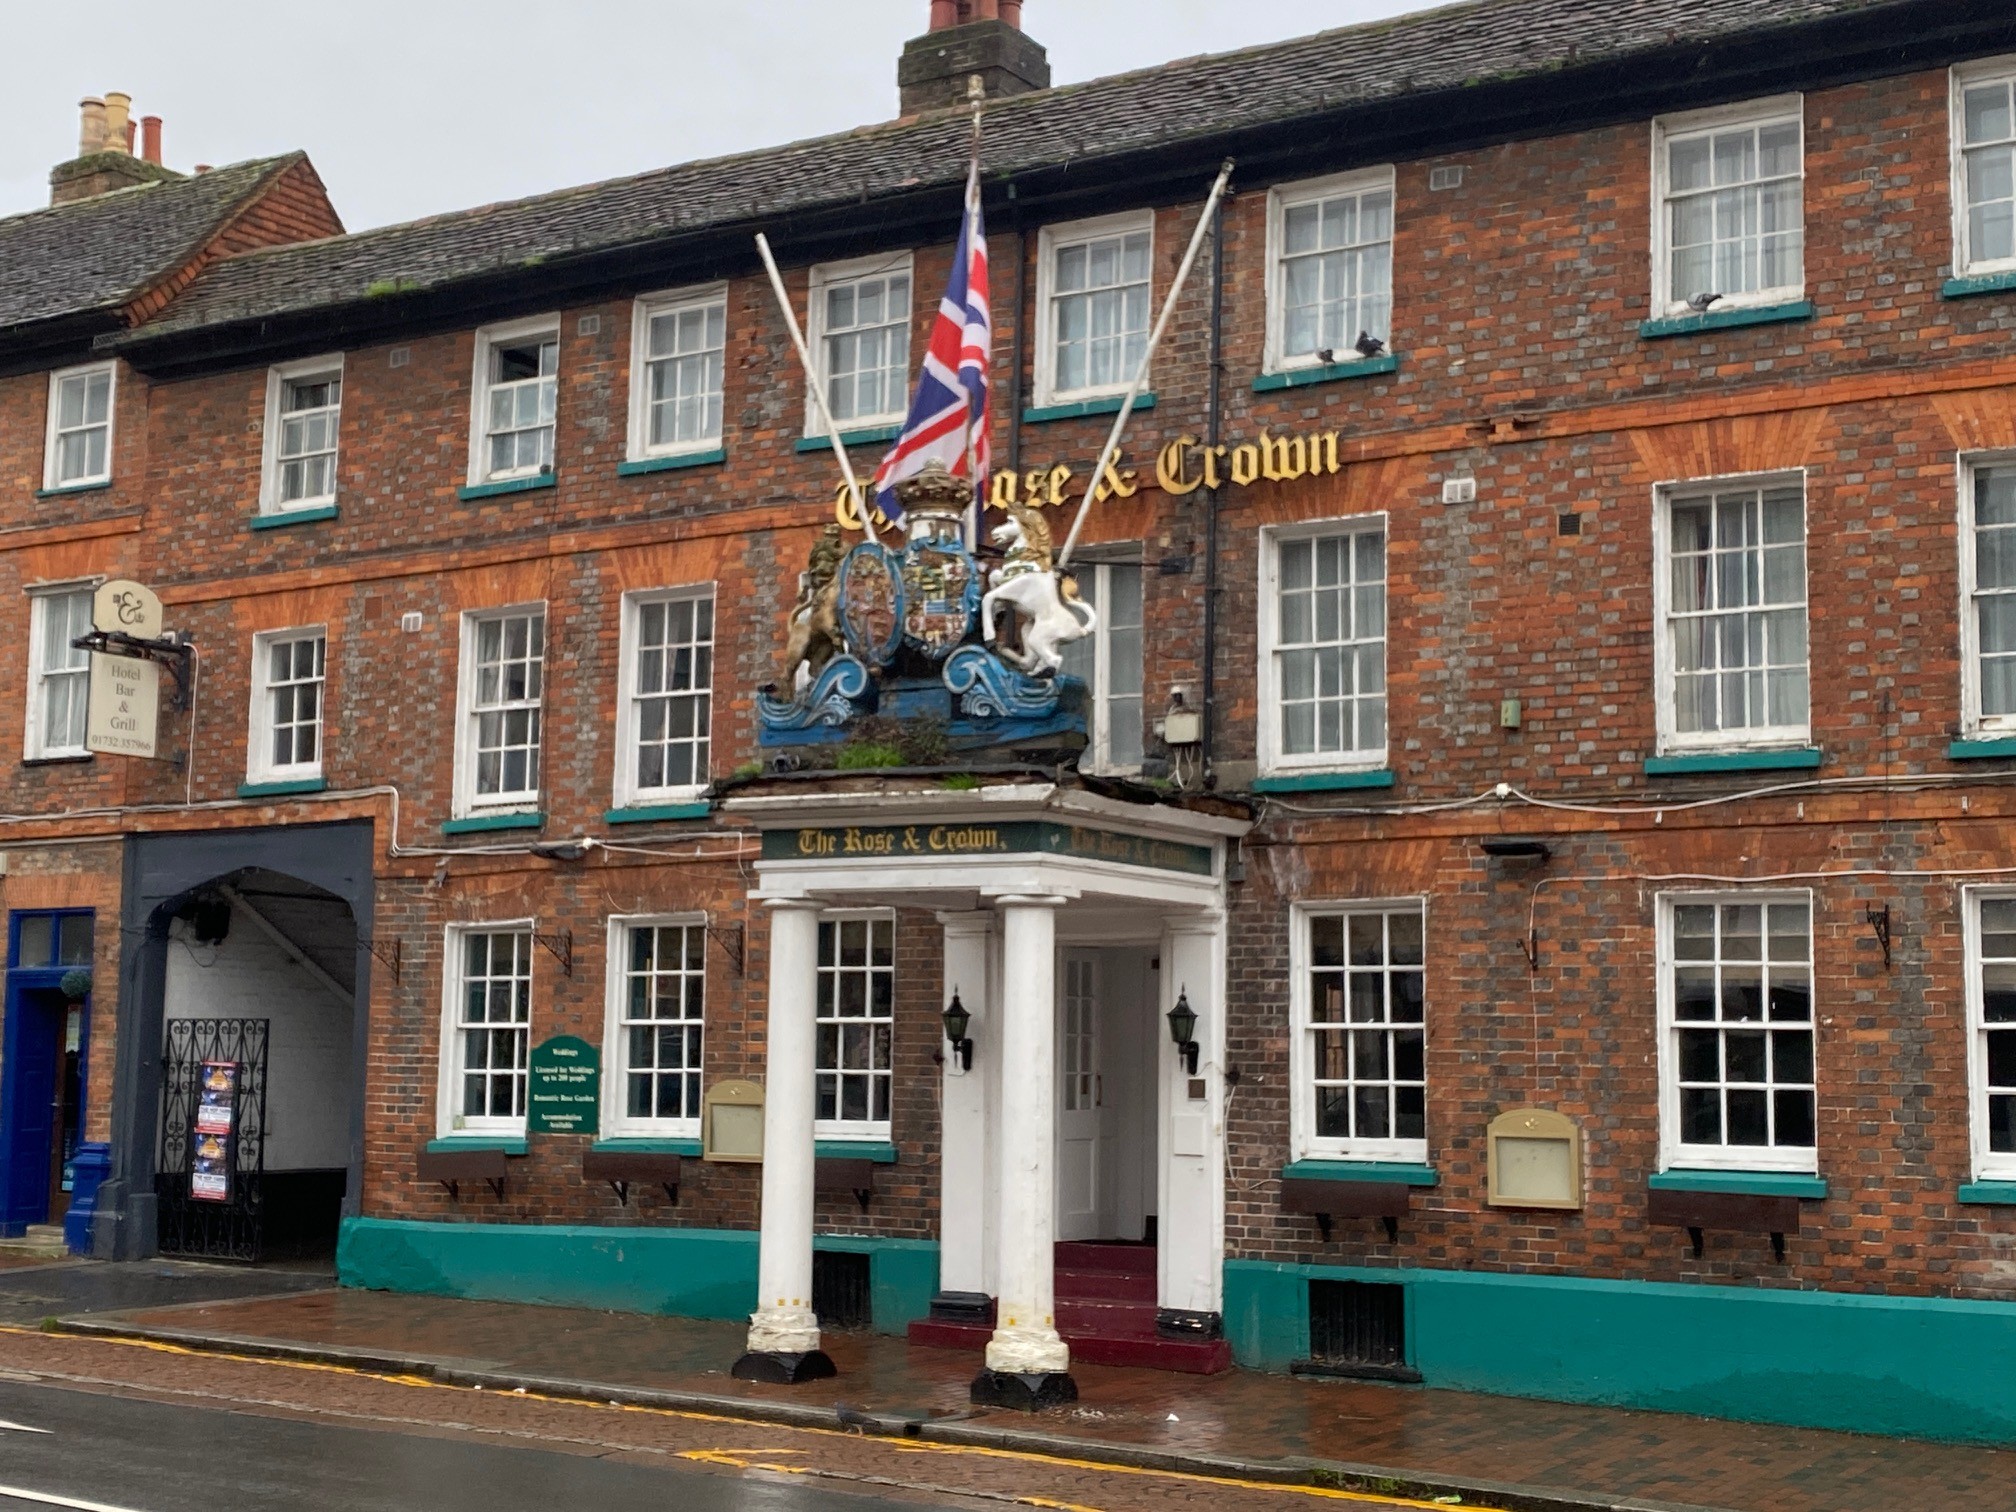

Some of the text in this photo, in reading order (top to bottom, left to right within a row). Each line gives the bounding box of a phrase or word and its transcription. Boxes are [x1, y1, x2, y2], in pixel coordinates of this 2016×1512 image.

[983, 464, 1072, 512] ose
[1094, 446, 1138, 503] &
[1156, 426, 1342, 496] Crown
[111, 664, 141, 681] Hotel
[115, 682, 135, 697] Bar
[118, 700, 128, 713] &
[110, 716, 136, 731] Grill
[800, 824, 998, 855] The Rose & Crown
